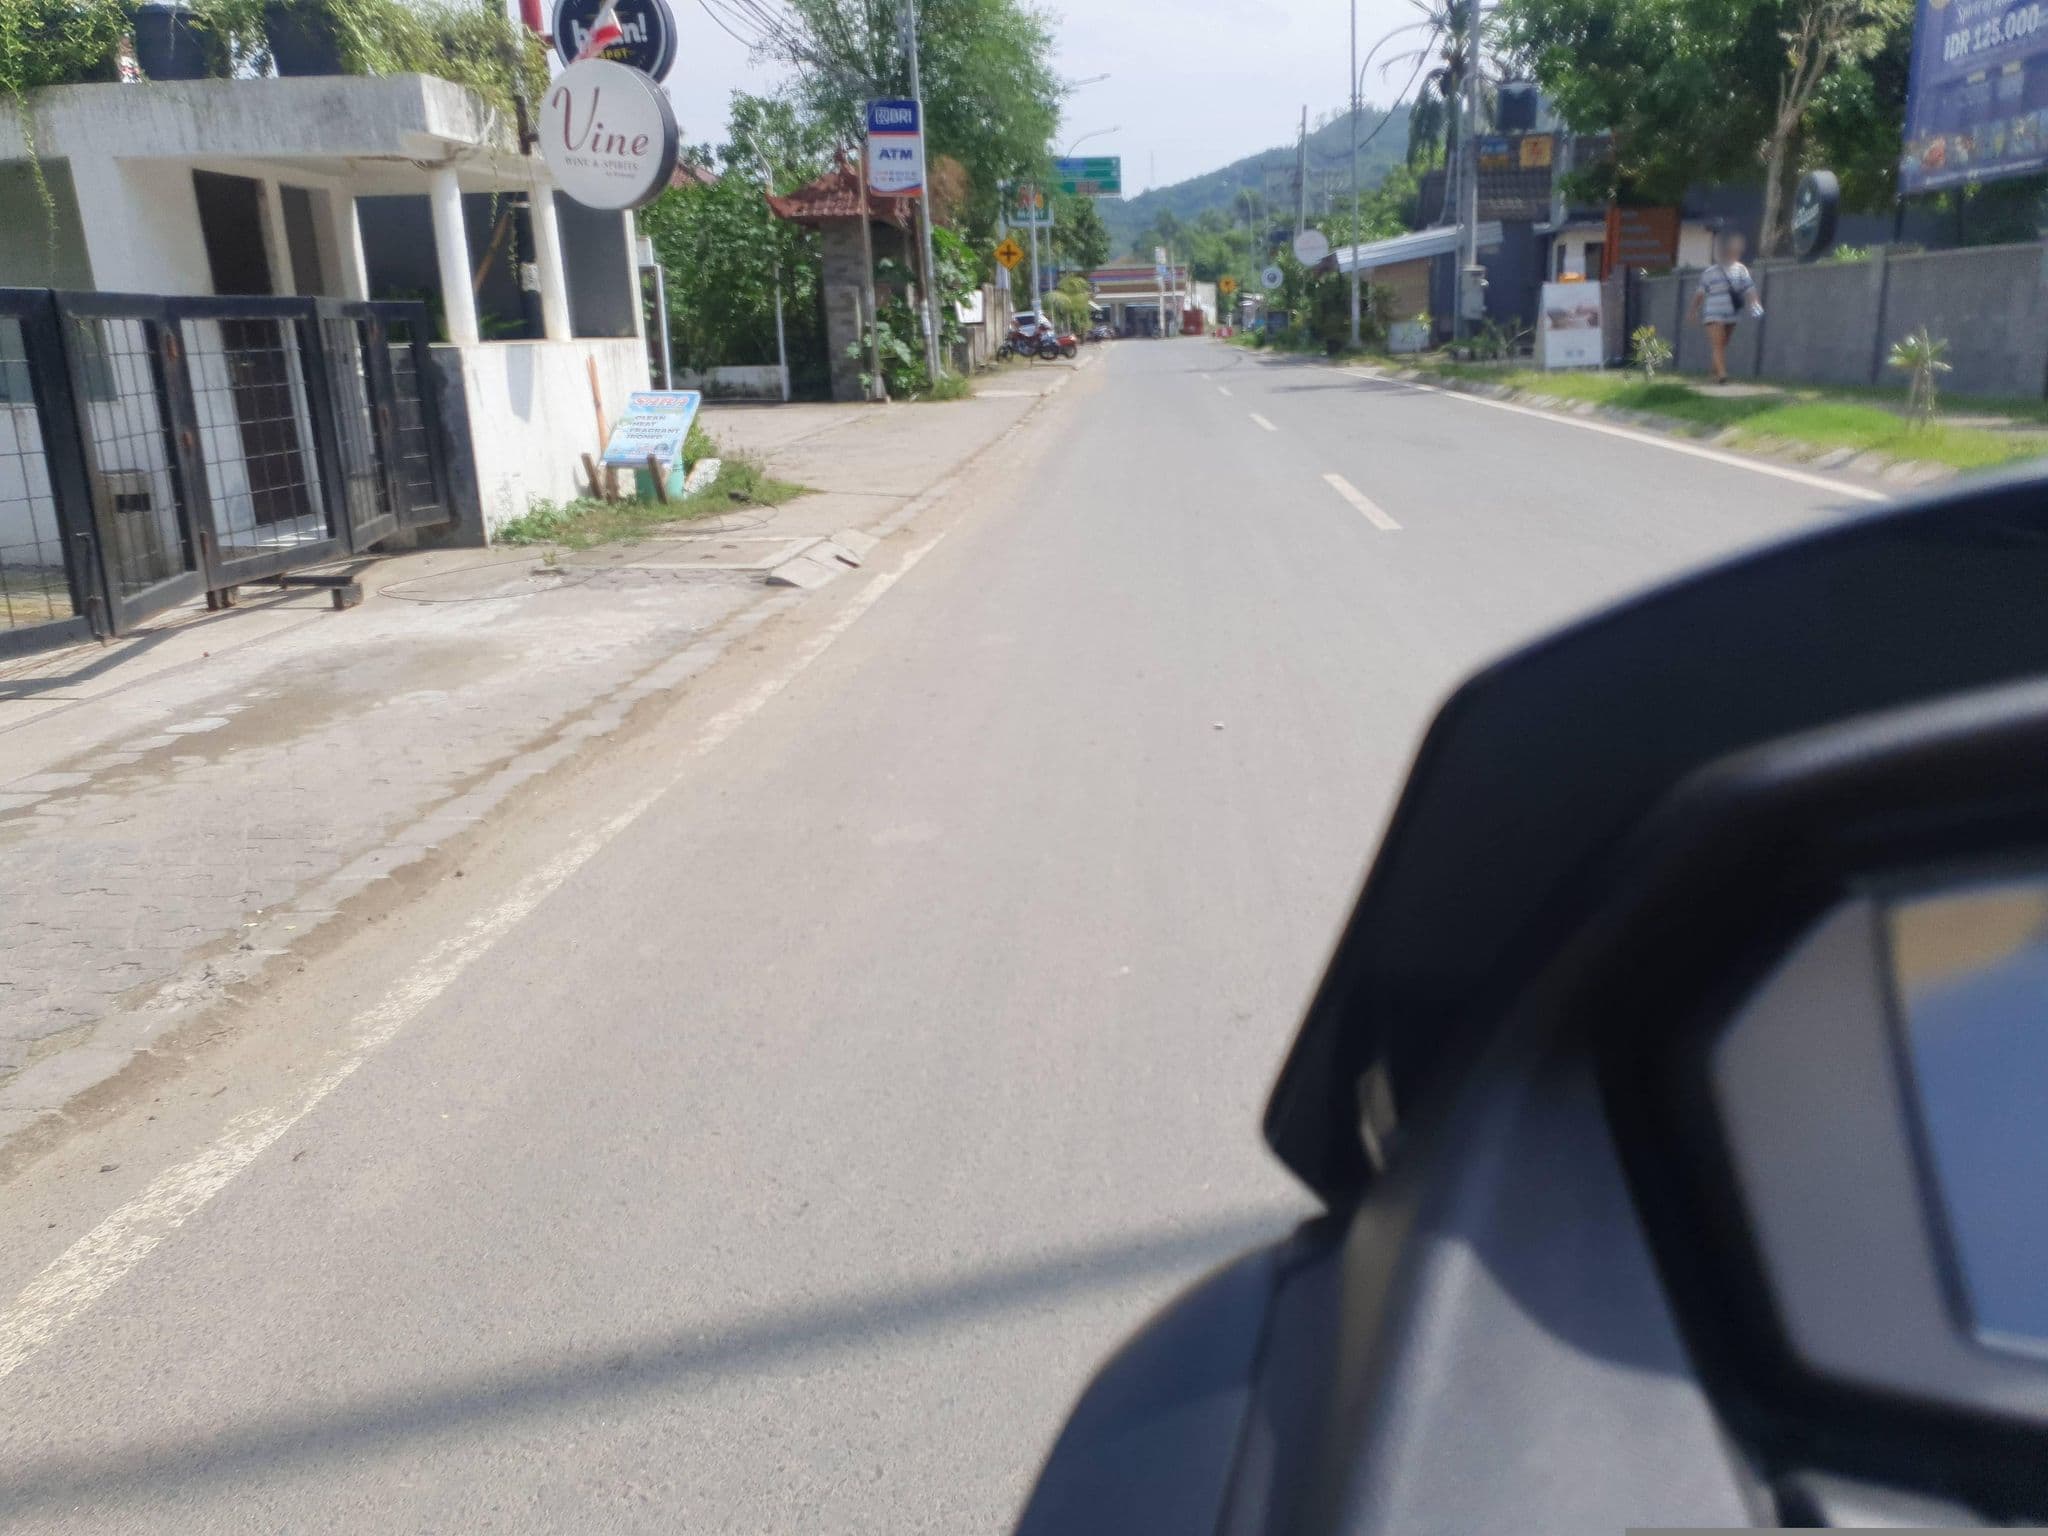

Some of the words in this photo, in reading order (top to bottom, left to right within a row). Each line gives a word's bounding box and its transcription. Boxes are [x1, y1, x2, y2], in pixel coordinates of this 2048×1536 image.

[1944, 28, 1970, 61] IDR
[552, 86, 649, 156] Vine
[889, 107, 912, 124] BRI
[565, 157, 590, 168] WINE
[879, 149, 913, 161] ATM
